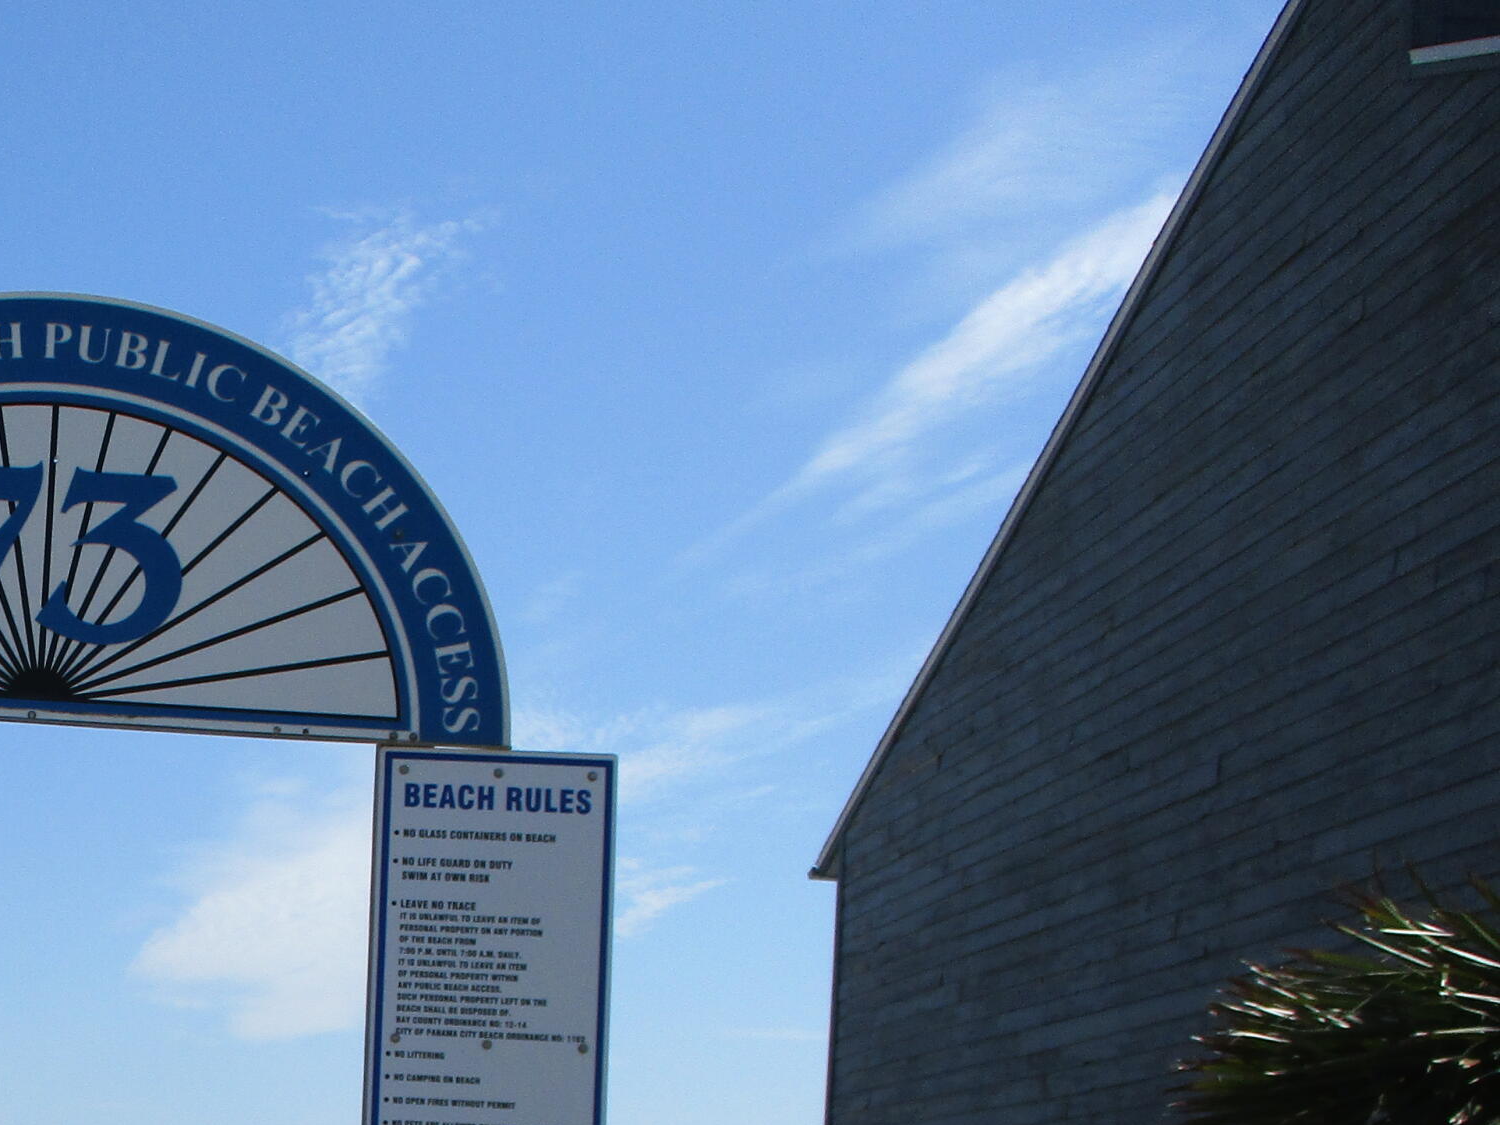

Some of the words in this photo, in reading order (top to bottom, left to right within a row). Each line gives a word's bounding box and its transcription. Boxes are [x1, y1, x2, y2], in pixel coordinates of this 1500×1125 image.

[44, 322, 248, 403] PUBLIC
[251, 383, 409, 531] BEACH
[389, 540, 481, 734] ACCESS
[404, 782, 494, 811] BEACH
[506, 786, 591, 815] RULES
[403, 828, 416, 838] NO
[418, 829, 447, 839] GLASS
[450, 830, 506, 841] CONTAINERS
[509, 832, 523, 842] ON
[525, 833, 556, 844] BEACH
[402, 857, 415, 866] NO
[417, 857, 436, 867] LIFE
[439, 858, 471, 868] GUARD
[473, 859, 486, 869] ON
[489, 860, 512, 870] DUTY
[402, 871, 428, 881] SWIM
[430, 872, 442, 881] AT
[445, 872, 466, 882] OWN
[469, 873, 489, 883] RISK
[400, 899, 429, 909] LEAVE
[431, 900, 444, 910] NO
[447, 901, 476, 911] TRACE
[399, 924, 437, 933] PERSONAL
[440, 925, 478, 934] PROPERTY
[481, 927, 492, 935] ON
[493, 928, 508, 936] ANY
[510, 928, 543, 937] PORTION
[394, 1050, 405, 1058] NO
[407, 1050, 445, 1060] LITTERING
[393, 1073, 405, 1081] NO
[406, 1074, 441, 1083] CAMPING
[442, 1075, 454, 1083] ON
[455, 1076, 481, 1085] BEACH
[392, 1096, 404, 1105] NO
[405, 1097, 426, 1105] OPEN
[427, 1098, 449, 1107] FIRES
[451, 1099, 485, 1108] WITHOUT
[487, 1101, 515, 1110] PERMIT
